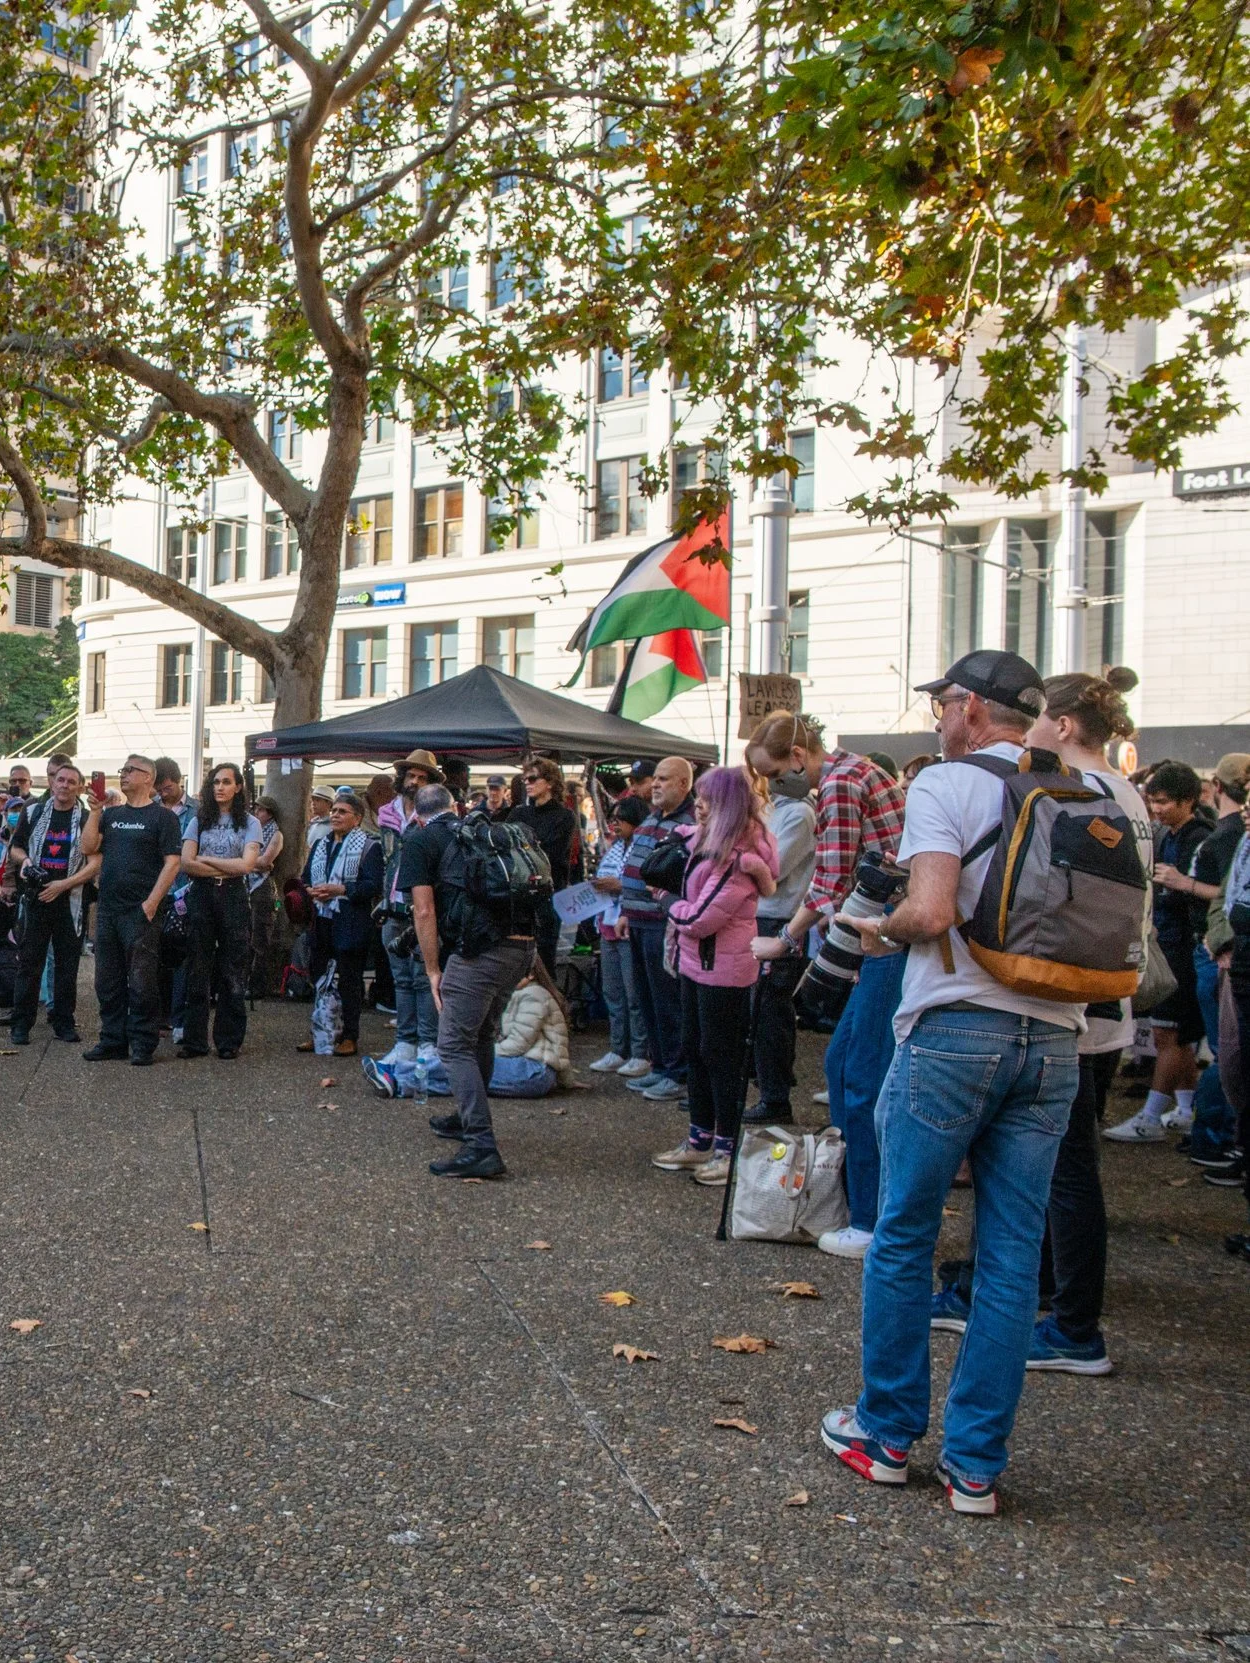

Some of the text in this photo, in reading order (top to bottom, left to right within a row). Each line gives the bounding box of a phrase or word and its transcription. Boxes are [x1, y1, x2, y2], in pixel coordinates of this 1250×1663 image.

[1182, 470, 1229, 490] Foot
[745, 677, 799, 699] LAWLESS
[117, 821, 145, 830] Columbia
